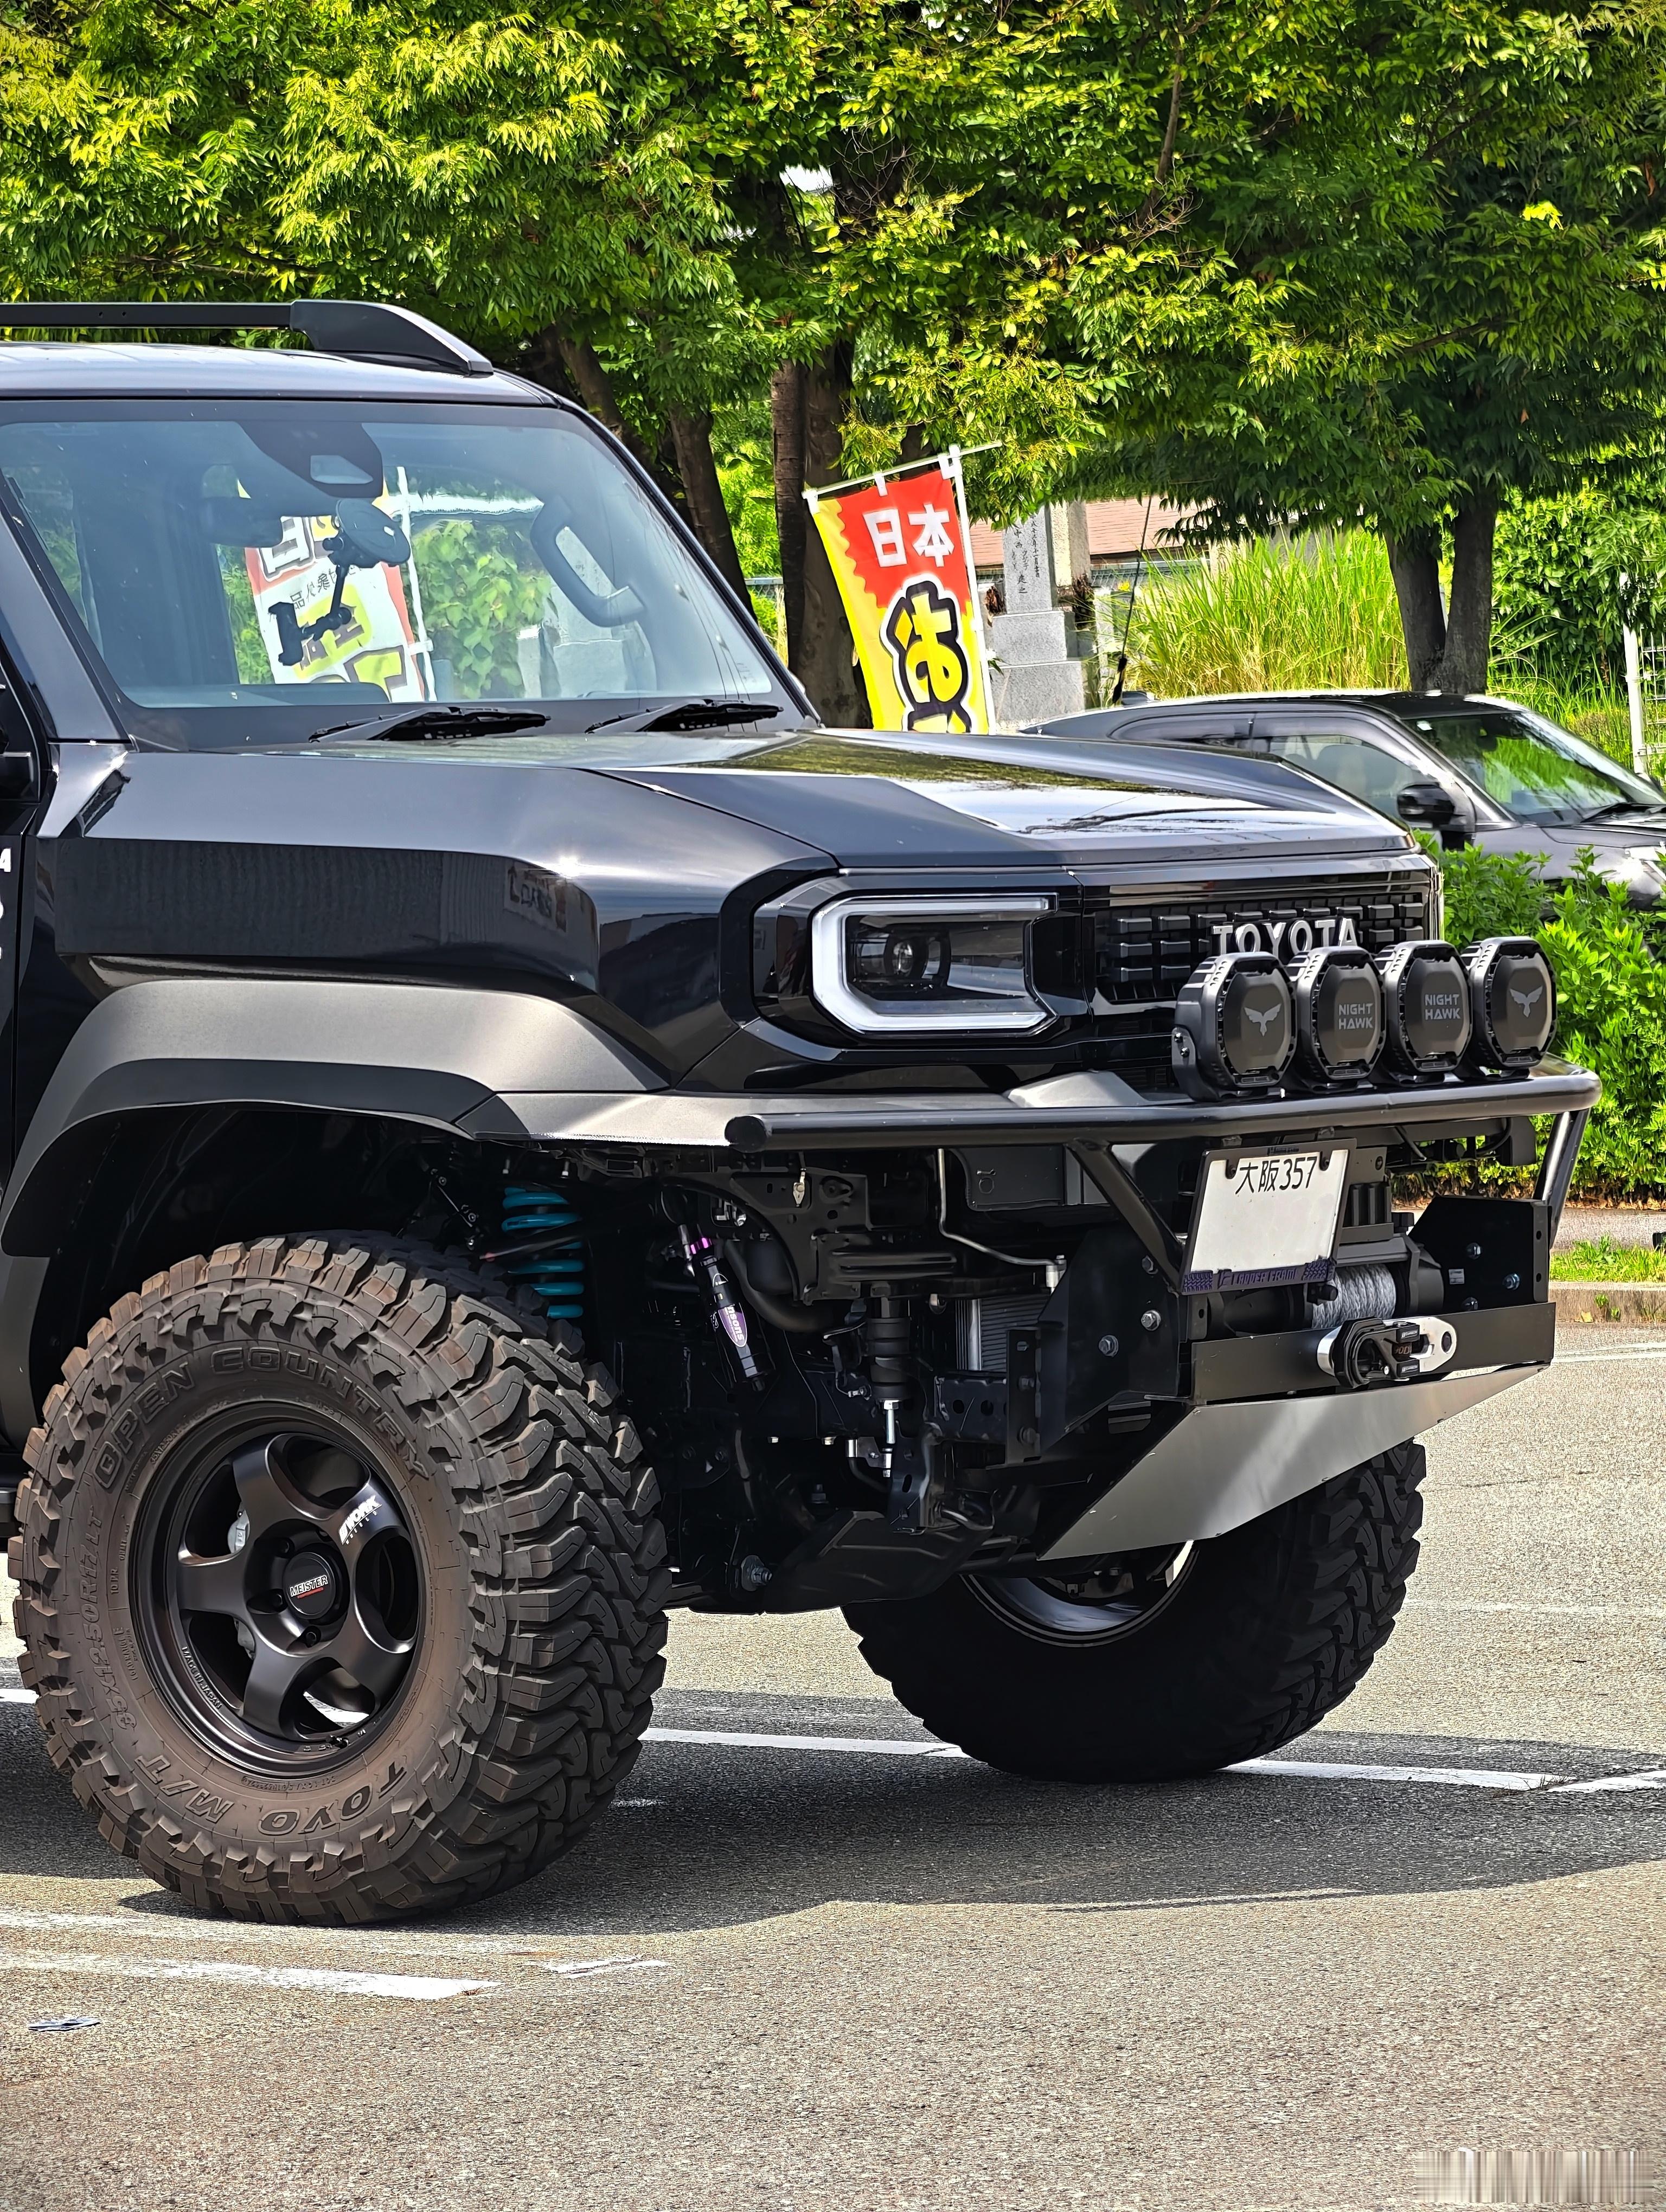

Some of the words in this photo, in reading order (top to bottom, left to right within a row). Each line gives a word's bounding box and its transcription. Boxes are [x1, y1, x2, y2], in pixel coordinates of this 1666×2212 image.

[1212, 917, 1358, 959] TOYOTA
[1338, 1003, 1373, 1016] NIGHT
[1425, 994, 1460, 1006] NIGHT
[1425, 1007, 1461, 1020] HAWK
[1338, 1017, 1373, 1030] HAWK
[93, 1361, 196, 1489] OPEN
[210, 1346, 430, 1481] COUNTRY
[342, 1495, 381, 1536] WORK
[290, 1574, 329, 1597] MEISTER
[134, 1754, 235, 1823] M/T
[257, 1760, 407, 1836] TOYO
